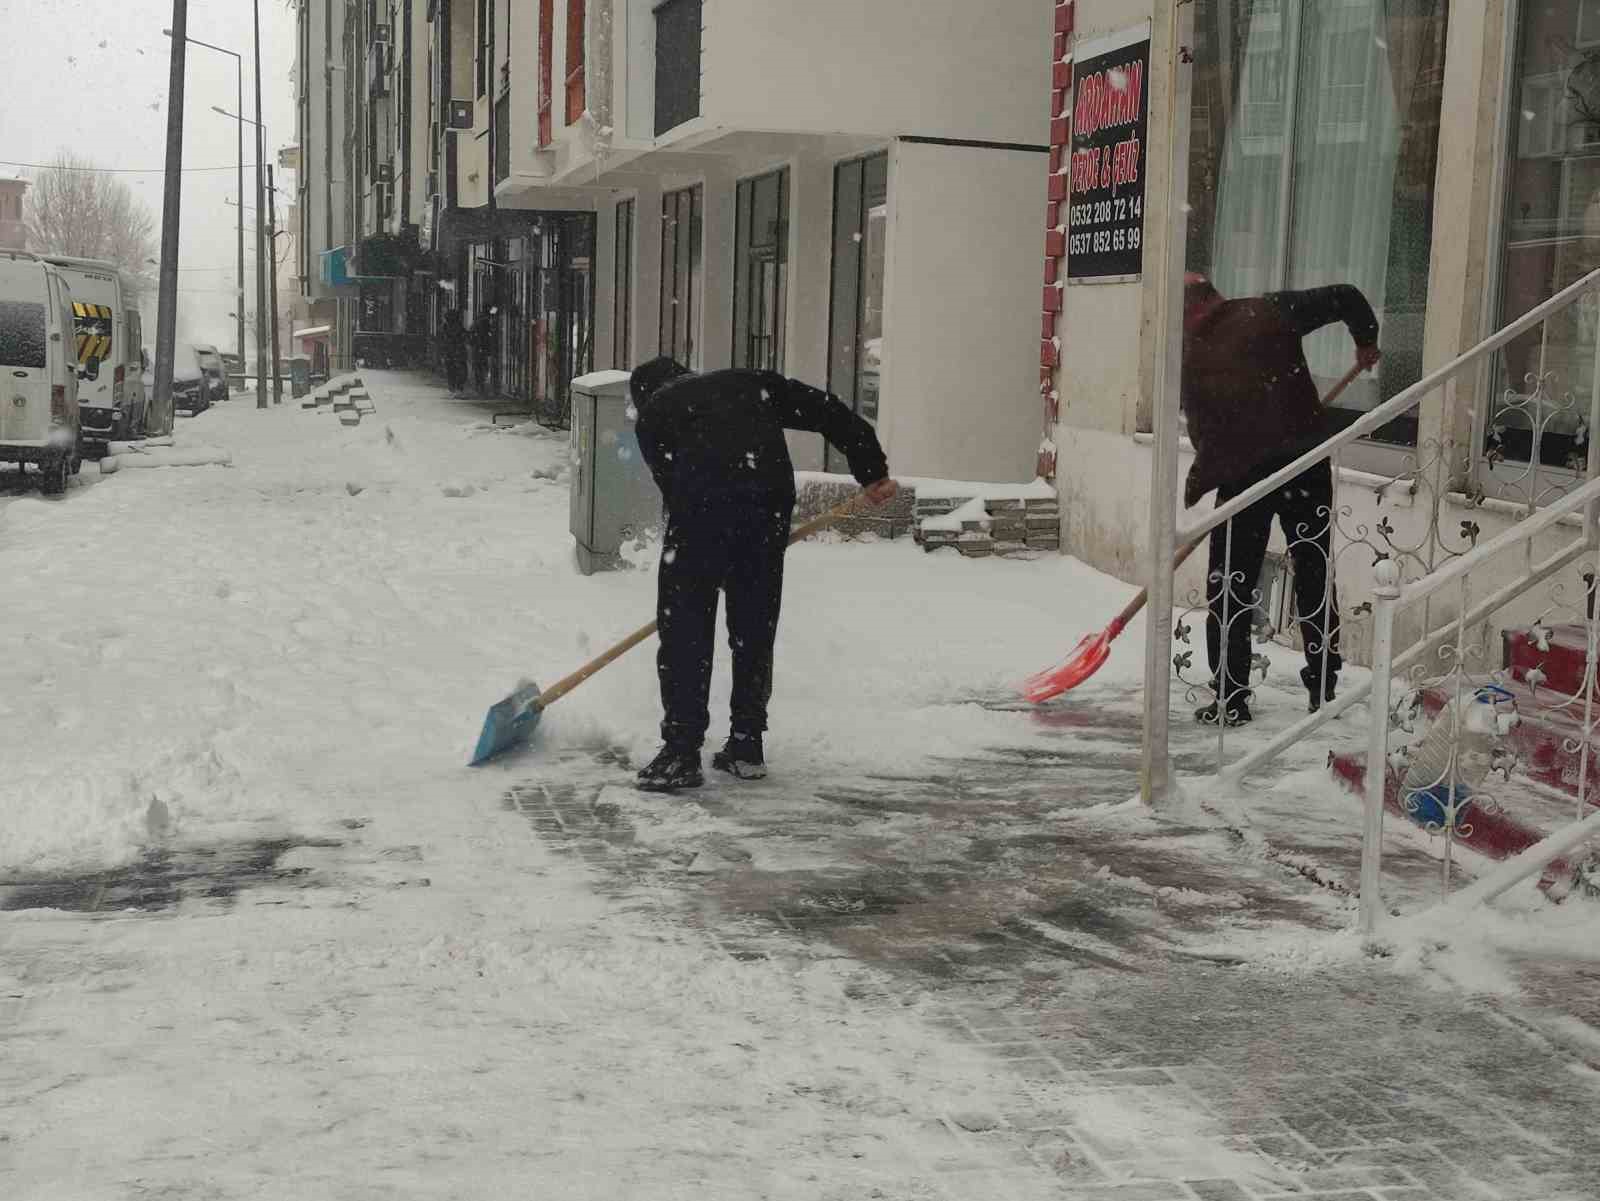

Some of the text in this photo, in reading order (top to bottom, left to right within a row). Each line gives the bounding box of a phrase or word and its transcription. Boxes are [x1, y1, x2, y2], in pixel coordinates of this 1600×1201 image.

[1071, 129, 1140, 198] PERDE & ÇEYİZ
[1070, 195, 1141, 226] 0532 208 72 14
[1069, 227, 1140, 255] 0537 852 65 99
